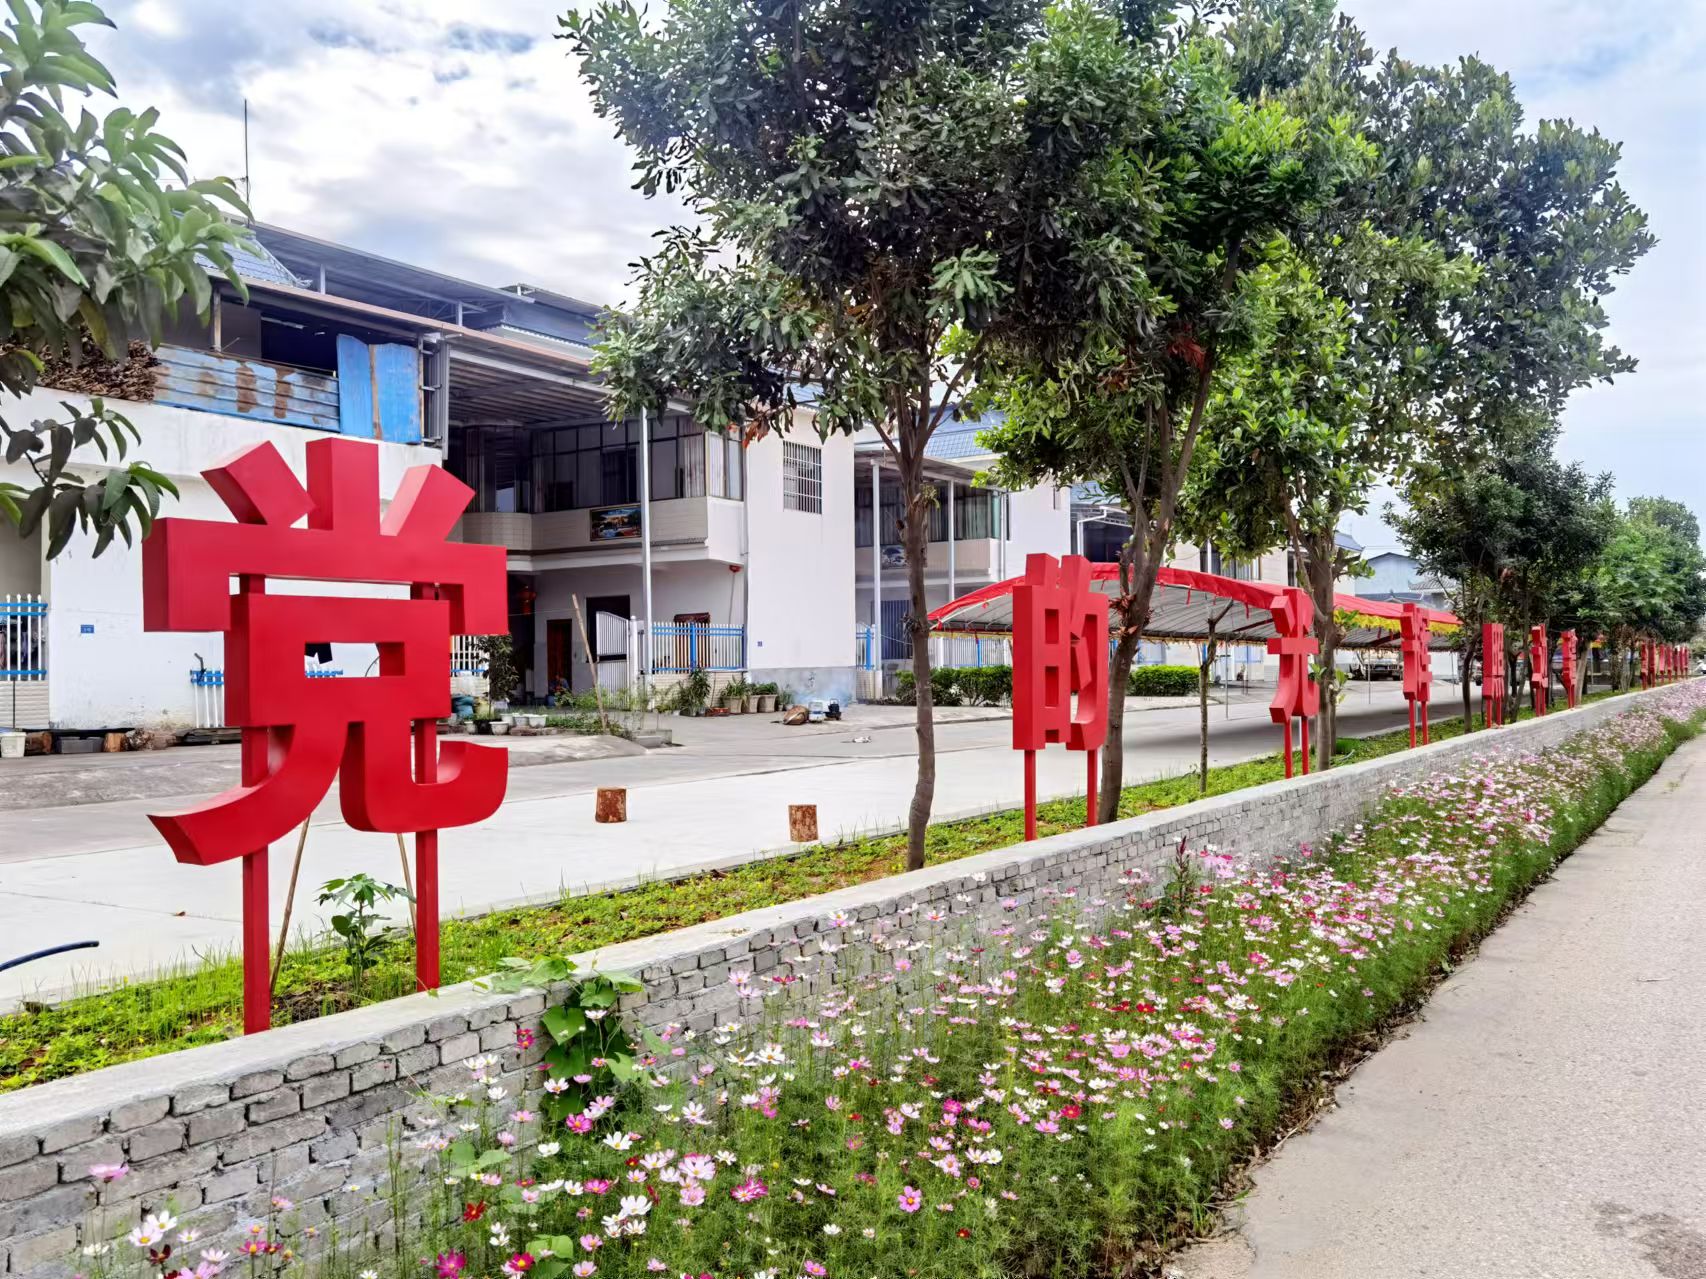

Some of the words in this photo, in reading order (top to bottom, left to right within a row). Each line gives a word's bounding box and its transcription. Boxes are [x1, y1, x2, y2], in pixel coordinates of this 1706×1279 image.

[142, 437, 509, 866] 党
[1013, 553, 1108, 751] 的
[1267, 588, 1319, 724] 光
